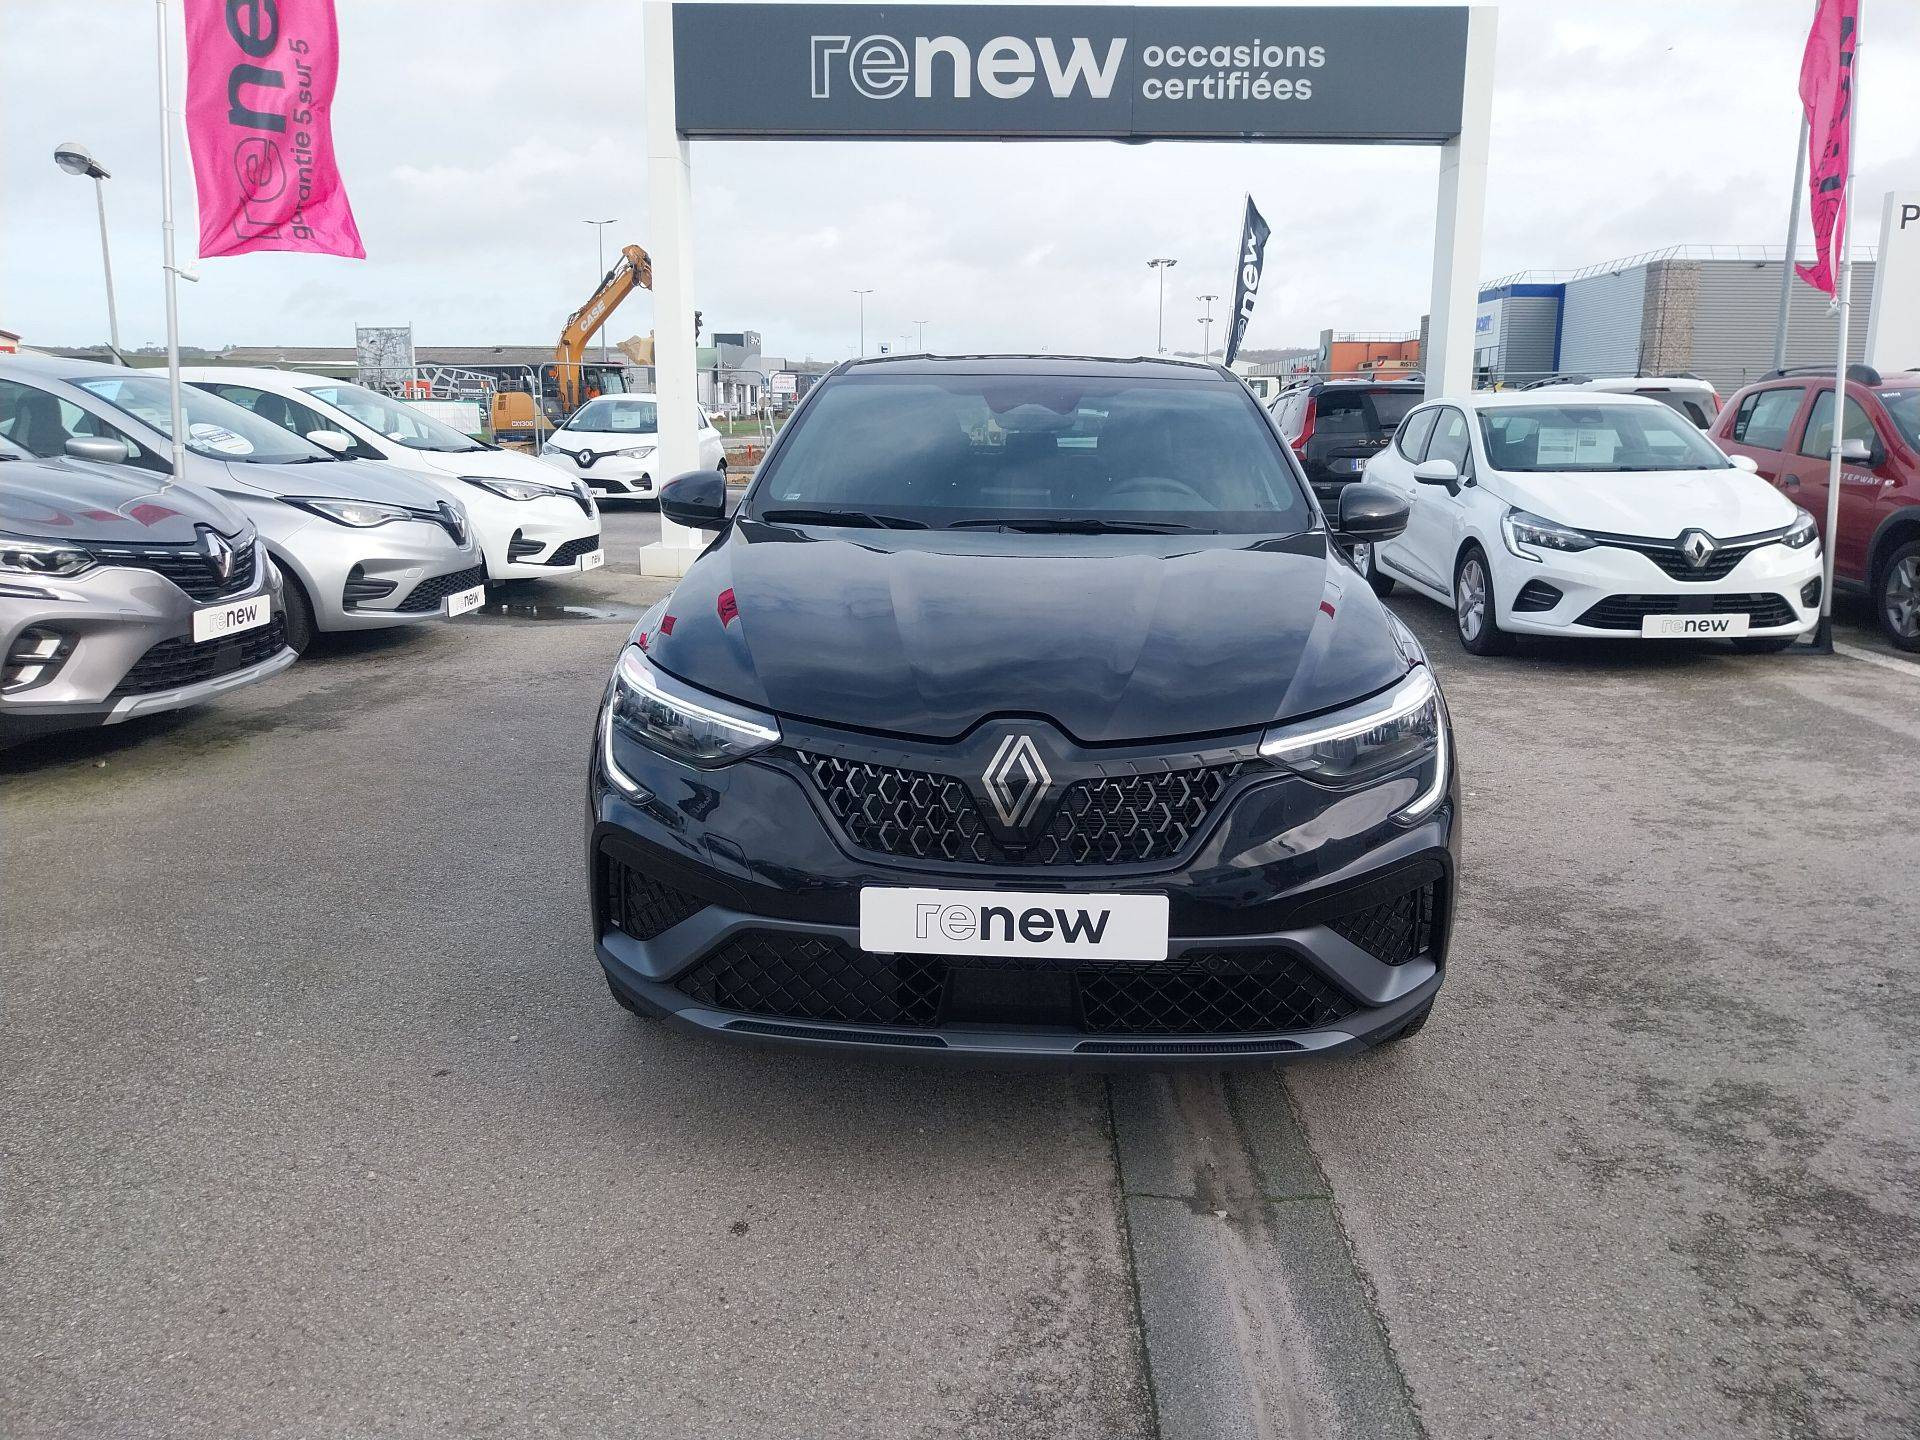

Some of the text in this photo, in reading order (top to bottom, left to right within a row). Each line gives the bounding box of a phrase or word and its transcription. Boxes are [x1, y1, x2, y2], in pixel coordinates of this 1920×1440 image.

[810, 35, 1128, 99] renew
[1142, 38, 1326, 68] occasions
[1142, 71, 1313, 100] certifiées
[288, 38, 316, 240] garantie 5 sur 5
[580, 300, 606, 332] CASE
[208, 604, 257, 632] renew
[1661, 619, 1730, 633] renew
[916, 903, 1111, 944] renew
